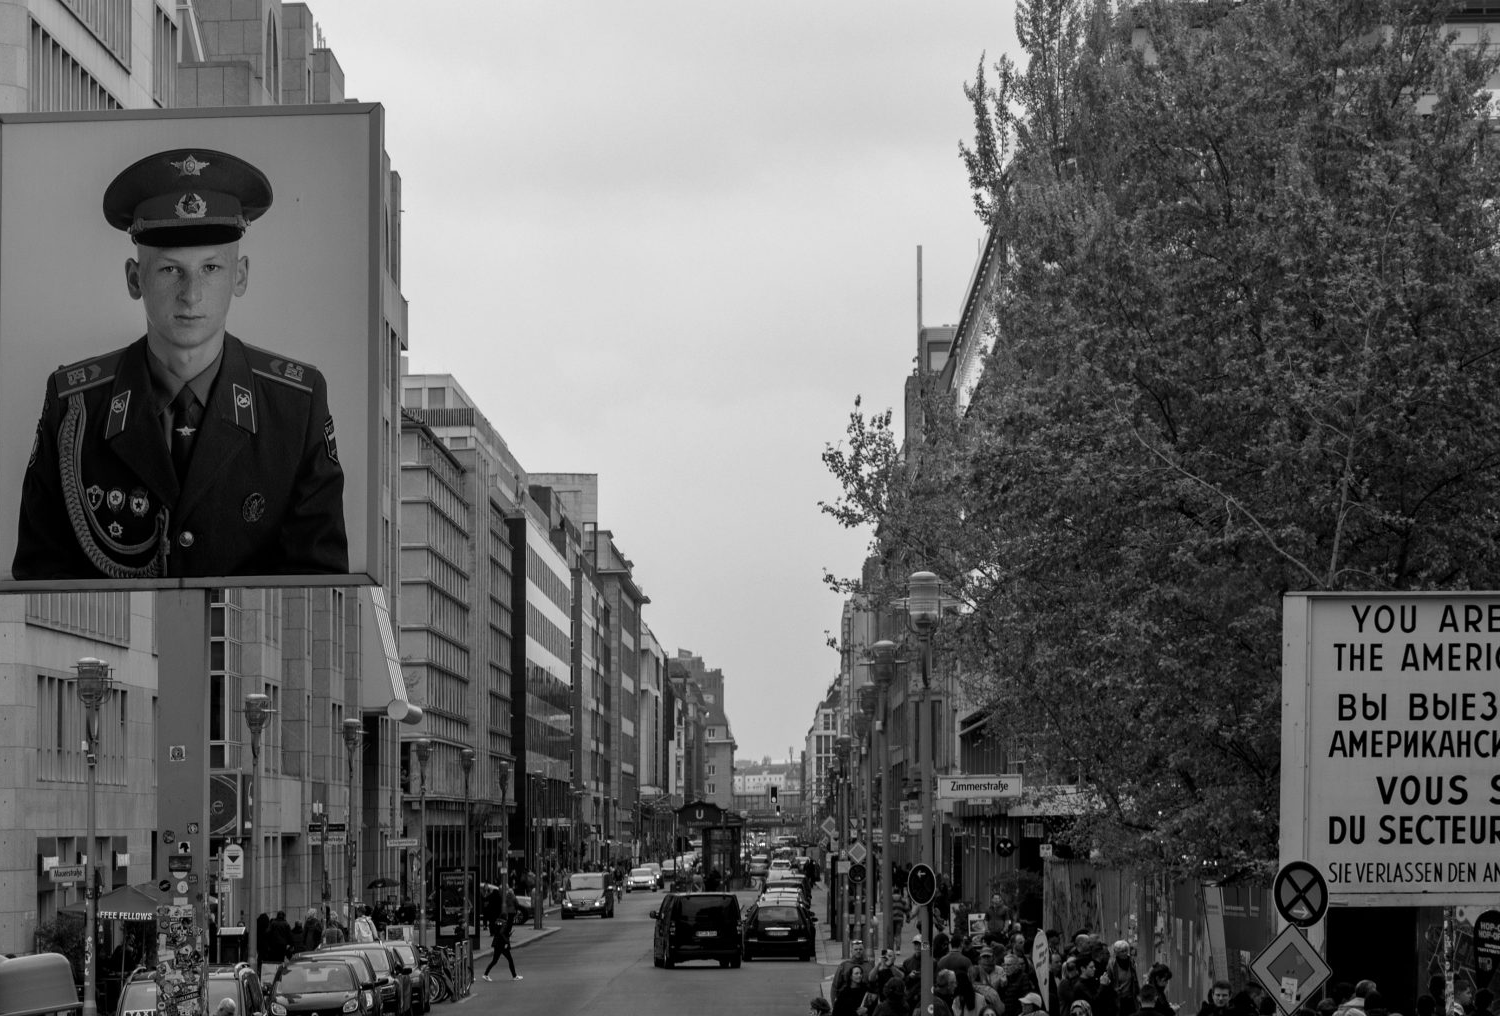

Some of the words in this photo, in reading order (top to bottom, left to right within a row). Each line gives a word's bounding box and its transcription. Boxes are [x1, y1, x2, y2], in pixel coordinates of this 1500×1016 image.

[1351, 604, 1417, 634] YOU
[1438, 604, 1500, 633] ARE
[1333, 643, 1383, 671] THE
[1400, 643, 1500, 671] AMERI
[1338, 693, 1387, 721] ВЫ
[1409, 691, 1498, 721] ВЫЕЗ
[950, 780, 1009, 793] Zimmerstraße
[1376, 775, 1468, 805] VOUS
[696, 808, 704, 820] U
[1328, 815, 1365, 845] DU
[1378, 815, 1500, 845] SECTEUR
[53, 869, 83, 879] Mauerstraße
[1328, 862, 1352, 883] SIE
[1355, 862, 1443, 883] VERLASSEN
[1448, 862, 1476, 883] DEN
[118, 911, 153, 920] FELLOWS
